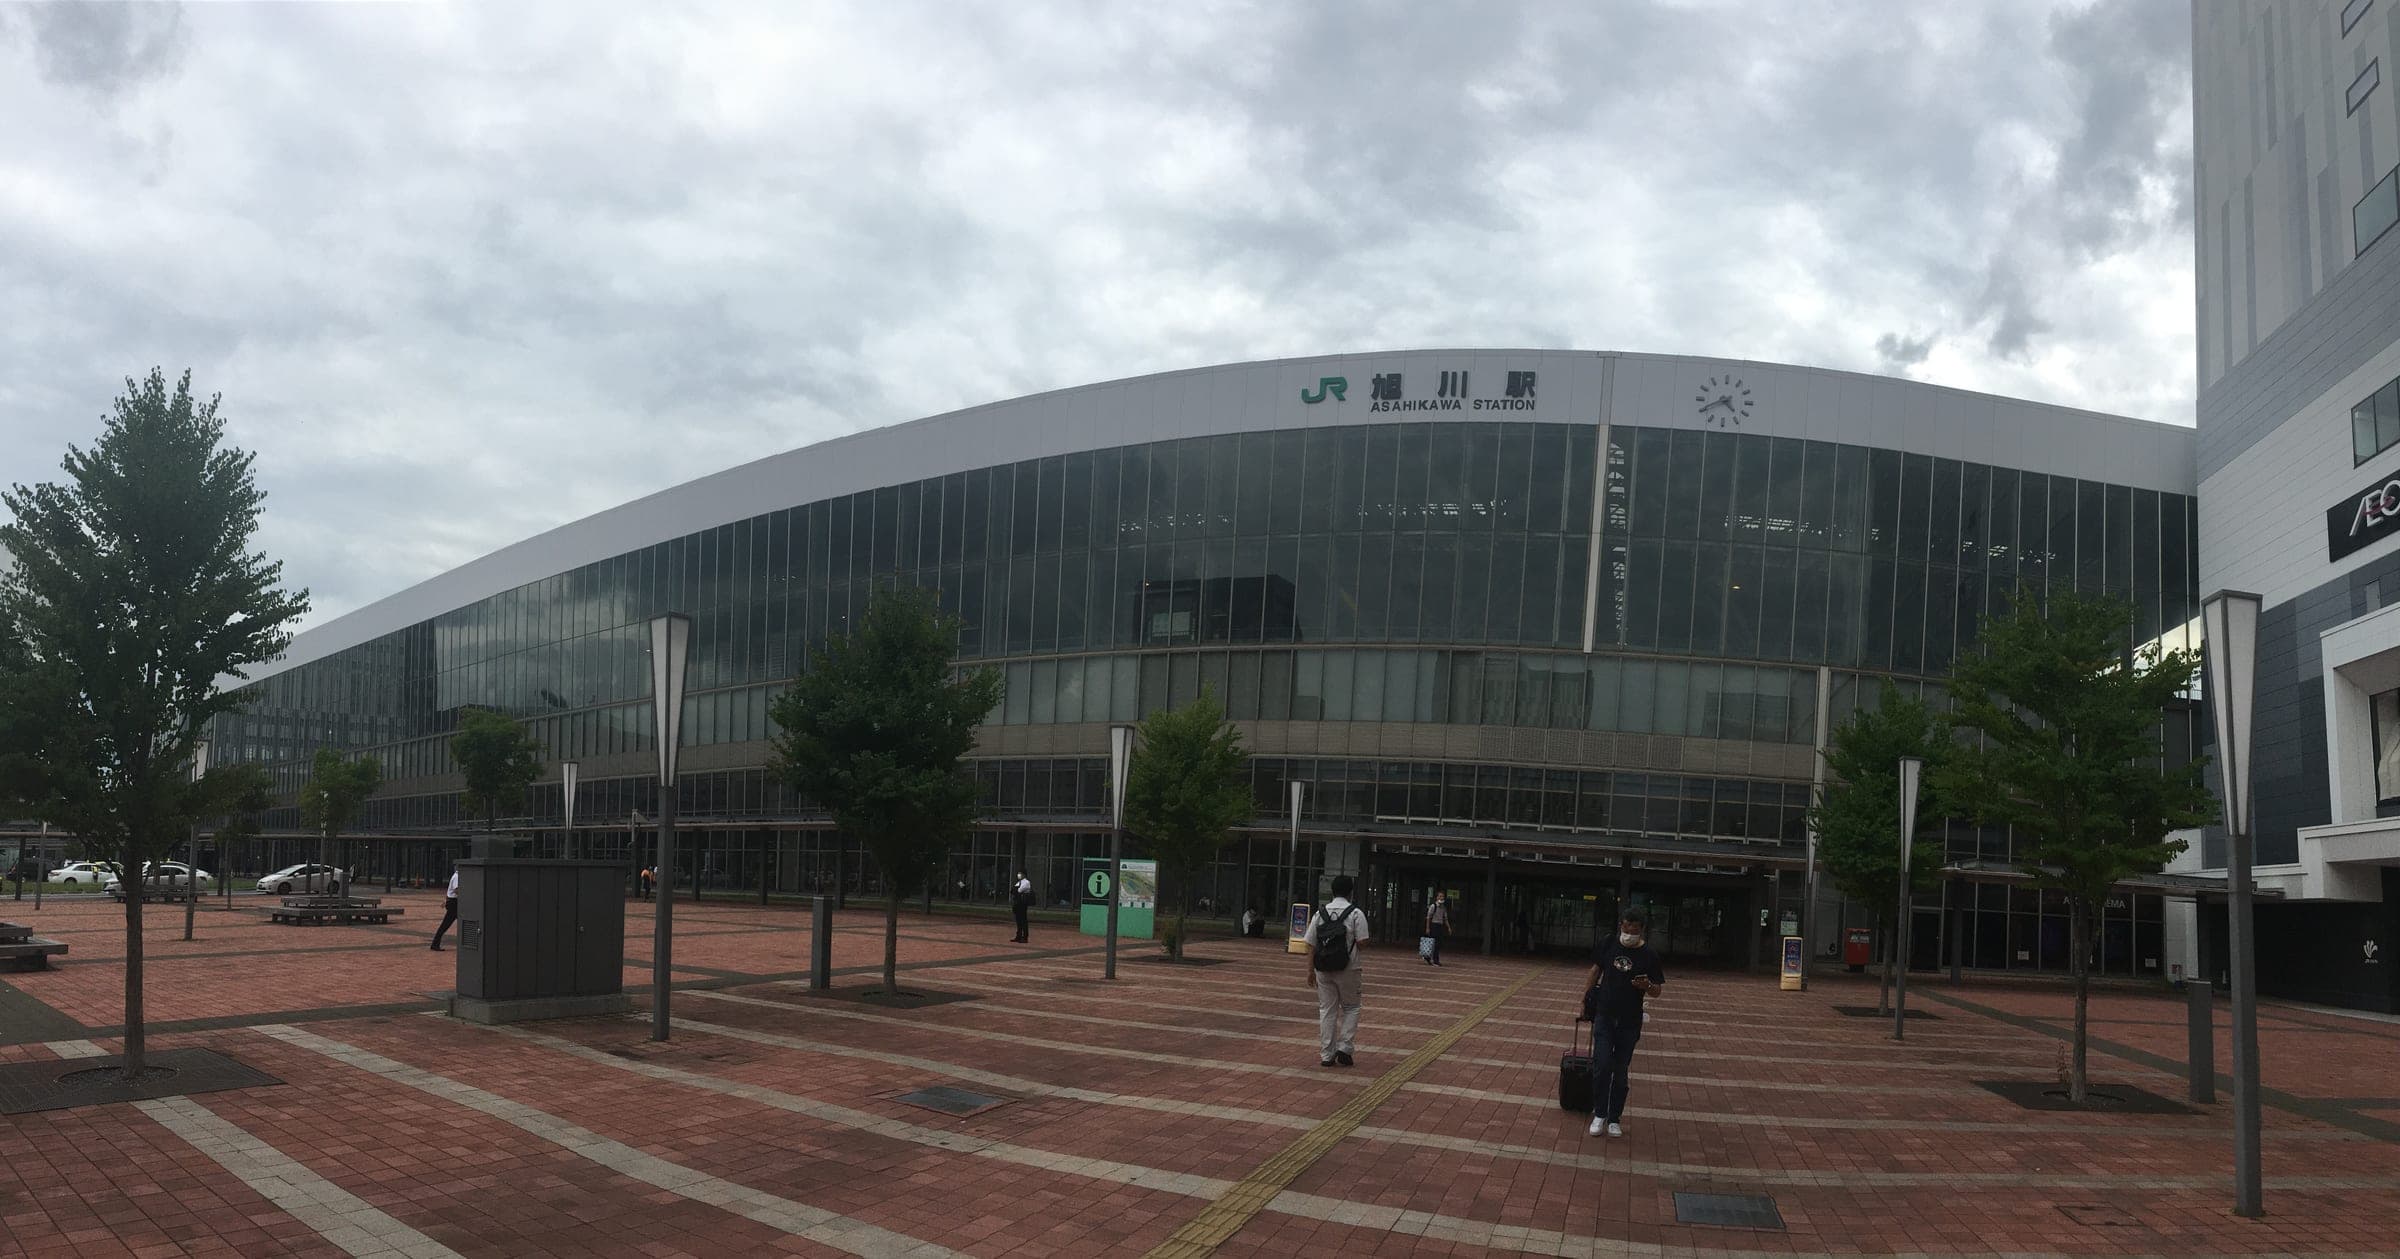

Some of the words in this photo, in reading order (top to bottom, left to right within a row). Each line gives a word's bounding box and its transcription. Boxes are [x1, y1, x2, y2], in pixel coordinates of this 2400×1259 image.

[1301, 376, 1348, 403] JR
[1371, 371, 1536, 400] 旭川駅
[1370, 399, 1462, 413] ASAHIKAWA
[1473, 399, 1535, 411] STATION
